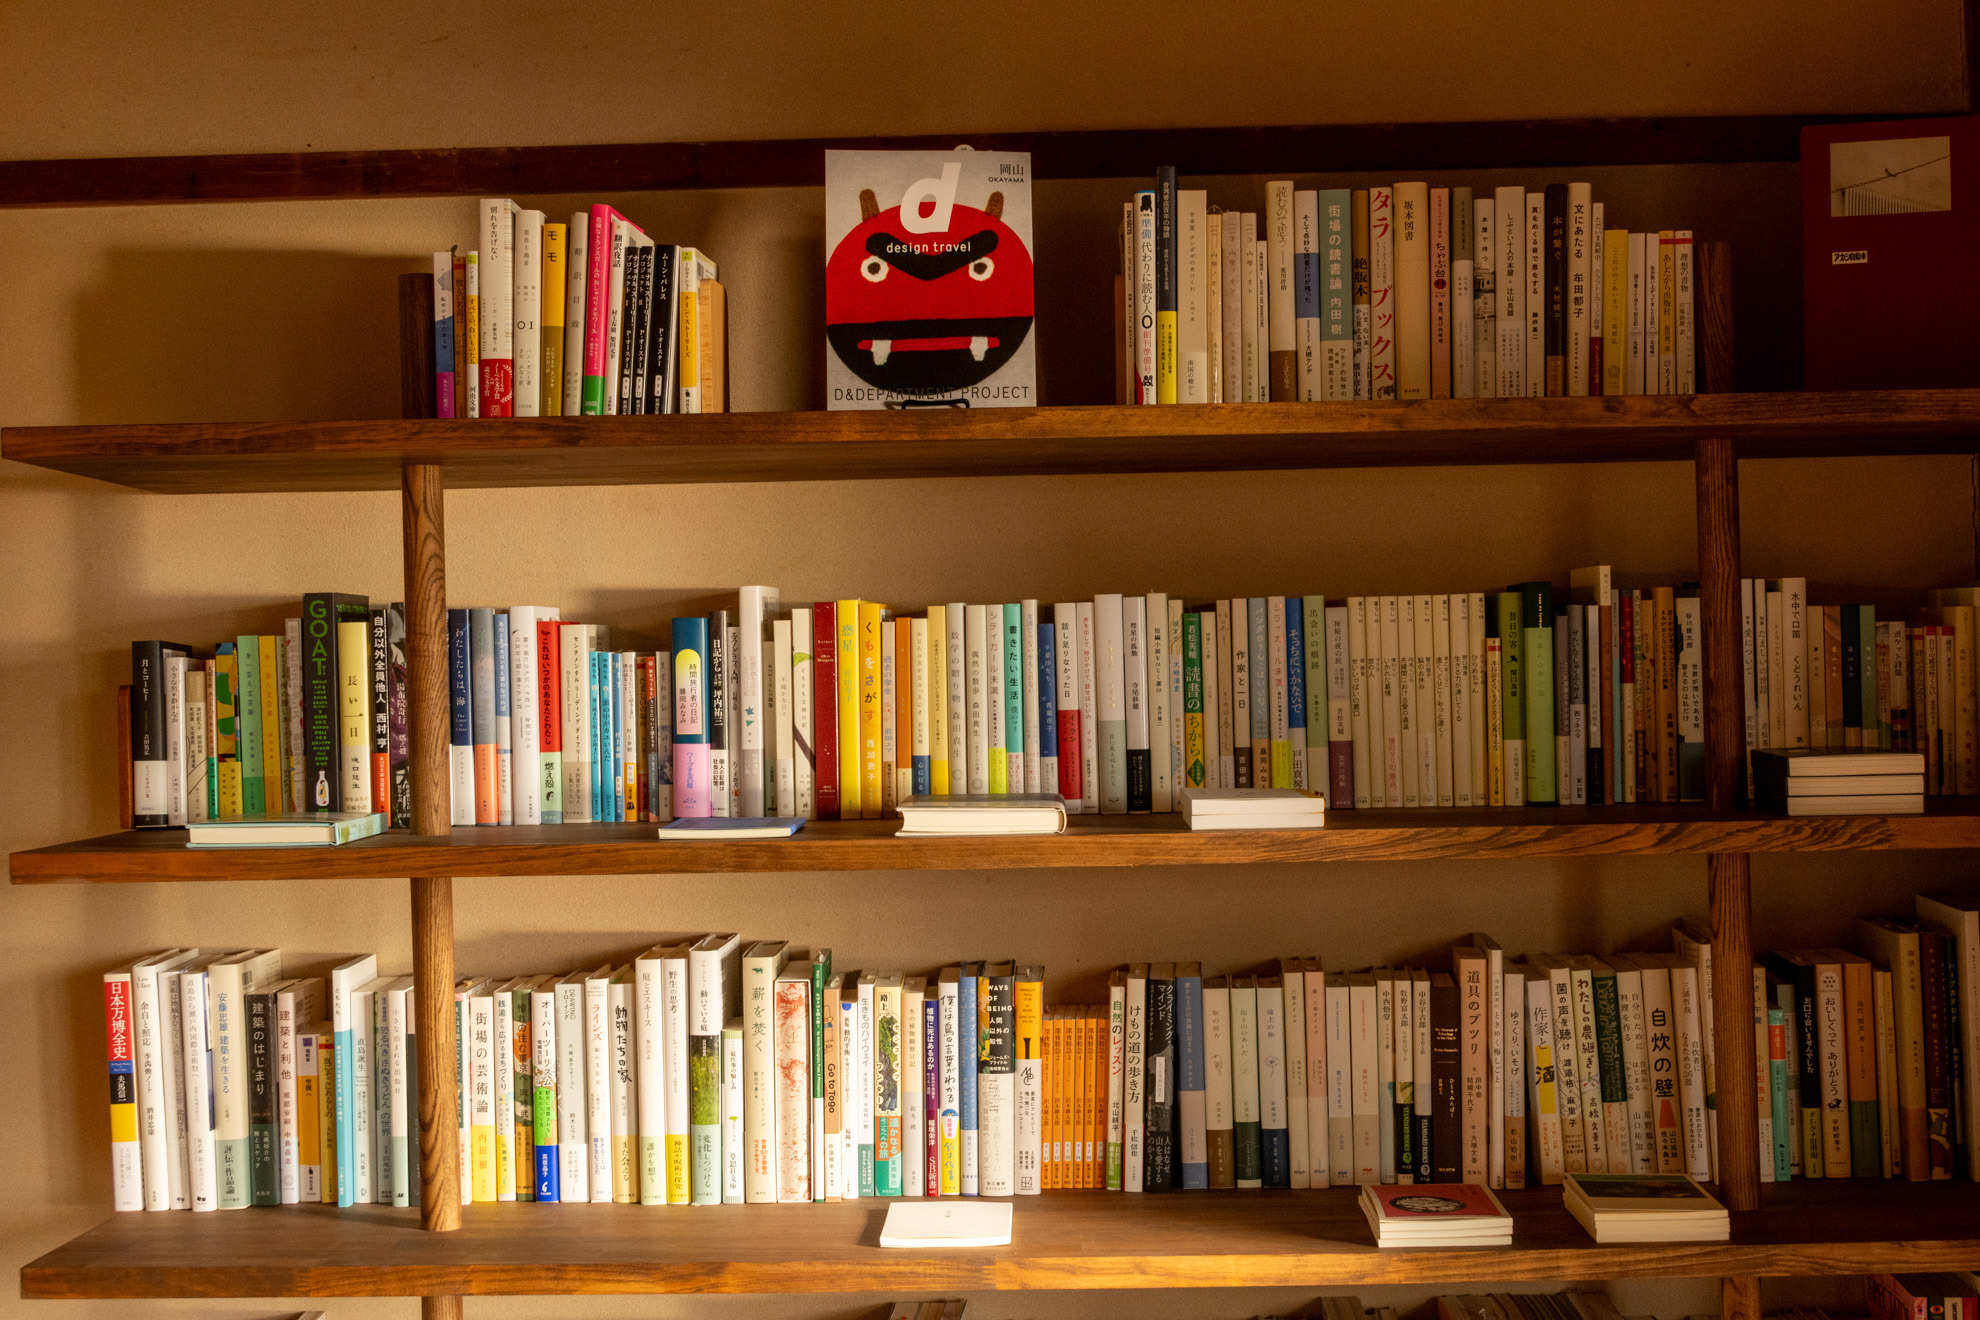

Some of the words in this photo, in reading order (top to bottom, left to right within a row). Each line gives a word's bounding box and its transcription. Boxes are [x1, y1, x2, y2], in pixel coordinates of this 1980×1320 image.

[1000, 163, 1024, 176] 岡山
[900, 163, 962, 234] d
[1403, 201, 1415, 241] 坂本図書
[489, 206, 499, 261] 別れを告げない
[548, 230, 559, 263] モモ
[613, 234, 623, 268] 翻訳夜話
[886, 242, 929, 254] design
[933, 241, 971, 253] travel
[1328, 204, 1343, 290] 街場の読書論
[1573, 204, 1584, 259] 文にあたる
[659, 253, 668, 300] ムーン・パレス
[1354, 258, 1368, 298] 絶版本
[1434, 242, 1447, 278] ちゃぶ台
[1680, 252, 1689, 293] 理想の書物
[1833, 252, 1867, 262] アカシ自動車
[1573, 273, 1584, 319] 牟田都子
[1663, 253, 1672, 316] あしたから出版社
[1330, 296, 1342, 336] 内田樹
[834, 387, 955, 401] D&DEPARTMENT
[961, 386, 1029, 399] PROJECT
[309, 599, 329, 676] GOAT
[1507, 612, 1518, 649] 昔日の客
[1685, 613, 1694, 649] 谷川俊太郎
[1790, 592, 1801, 639] 水中で口笛
[373, 616, 387, 704] 自分以外全員他人
[714, 639, 722, 675] 日記から
[731, 631, 739, 683] エスノグラフィ入門
[841, 628, 854, 653] 惑星
[990, 610, 1000, 696] シティガール未満
[1060, 621, 1070, 699] 話し足りなかった日
[1130, 621, 1138, 657] 彗星の孤独
[1152, 627, 1161, 694] 短編小説をひらく喜び
[1186, 625, 1198, 660] 若松英輔
[1253, 608, 1266, 695] パンダのうんこはいい匂い
[1308, 609, 1320, 671] 出会いの痕跡
[1333, 620, 1343, 664] 神秘の夜の旅
[1744, 628, 1753, 676] 愛について
[1758, 629, 1768, 695] たましいの世話
[1892, 630, 1903, 677] ポケット詩集
[142, 659, 150, 701] 月とコーヒー
[455, 627, 465, 706] わたしたちは、海
[864, 621, 877, 723] くもをさがす
[884, 655, 893, 696] 過去の学生
[951, 631, 962, 704] 数学の贈り物
[972, 650, 982, 696] 偶然の散歩
[1009, 624, 1019, 702] 書きたい生活
[1234, 654, 1246, 710] 作家と一日
[1289, 630, 1302, 714] そっちにいかないで
[1417, 657, 1425, 691] 脳のお休み
[1510, 669, 1518, 698] 関口良雄
[1792, 654, 1802, 711] くどうれいん
[343, 675, 364, 738] 長い一日
[396, 682, 407, 725] 湯布院奇行
[542, 637, 552, 746] これはいつかのあなたとわたし
[679, 687, 687, 724] 藤岡みなみ
[689, 663, 698, 724] 時間旅行者の日記
[714, 691, 724, 726] 坪内祐三
[1185, 671, 1201, 711] 読書の
[1454, 655, 1463, 722] 生きる力が湧いてくる
[1681, 664, 1689, 721] 答えるのは私だけ
[1692, 663, 1700, 728] 世界が問いである時
[885, 727, 893, 753] 前田エマ
[953, 711, 963, 759] 森田真生
[974, 702, 982, 738] 森田真生
[1188, 714, 1202, 762] ちから
[351, 757, 361, 789] 滝口悠生
[545, 761, 555, 789] 燃え殻
[866, 738, 876, 782] 西加奈子
[642, 972, 653, 1028] 庭とエスキース
[668, 970, 679, 1014] 野生の思考
[700, 989, 709, 1032] 動いている庭
[880, 993, 888, 1012] 路上
[987, 984, 1009, 992] WAYS
[1157, 984, 1166, 1022] マインド
[1382, 990, 1392, 1022] 中西悟堂
[1399, 989, 1409, 1028] 牧野富太郎
[1418, 990, 1427, 1029] 中谷宇吉郎
[1682, 982, 1692, 1014] 三浦哲哉
[111, 981, 128, 1060] 日本万博全史
[140, 1002, 152, 1047] 余白と照応
[217, 993, 229, 1031] 安藤忠雄
[592, 1003, 602, 1041] ラインズ
[751, 987, 767, 1053] 薪を焚く
[861, 997, 870, 1066] 生きものハイウェイ
[989, 1017, 1003, 1025] 人間
[989, 1027, 1010, 1035] 以外の
[1240, 1009, 1249, 1057] 街と山のあいだ
[1266, 1009, 1276, 1039] 途上の旅
[1467, 970, 1482, 1055] 道具のブツリ
[1533, 1006, 1549, 1050] 作家と
[1555, 983, 1571, 1052] 菌の声を聴け
[1577, 978, 1593, 1070] わたしの農継ぎ
[1620, 994, 1632, 1042] 料理を作る
[1631, 993, 1643, 1051] 自分のために
[1824, 997, 1835, 1048] おいしくって
[253, 1003, 266, 1096] 建築のはじまり
[280, 1010, 293, 1080] 建築と利他
[357, 1036, 367, 1073] 直島誕生
[393, 1009, 403, 1096] 小さな泊まれる出版社
[541, 1000, 553, 1087] オーバーツーリズム
[615, 1005, 632, 1084] 動物たちの家
[843, 1029, 851, 1055] 動的平衡
[926, 1007, 934, 1070] 植物に死はあるのか
[942, 995, 956, 1104] 僕には鳥の言葉がわかる
[989, 1038, 1004, 1046] 知性
[1112, 999, 1123, 1076] 自然のレッスン
[1127, 1006, 1142, 1105] けもの道の歩き方
[1510, 1011, 1520, 1076] ゆっくり、いそげ
[1650, 1008, 1676, 1098] 自炊の壁
[1690, 1040, 1701, 1072] 自炊者に
[1803, 997, 1814, 1074] お口に合いませんでした
[170, 979, 180, 1041] 美術は地域をひらく
[177, 1107, 186, 1140] 北川フラム
[220, 1035, 230, 1095] 建築を生きる
[476, 1011, 490, 1114] 街場の芸術論
[828, 1063, 836, 1080] Go
[1535, 1065, 1555, 1086] 酒
[1828, 1051, 1840, 1097] ありがとう
[284, 1092, 292, 1126] 堀部安嗣
[323, 1057, 334, 1119] 既にそこにあるもの
[829, 1090, 837, 1114] Togo
[1466, 1076, 1475, 1115] 結城千代子
[1475, 1076, 1483, 1099] 田中幸
[1112, 1102, 1120, 1132] 北山耕平
[1589, 1096, 1601, 1153] 高橋久美子
[1632, 1111, 1643, 1150] 山口祐加
[285, 1131, 293, 1166] 中島岳志
[478, 1131, 489, 1169] 内田樹
[646, 1142, 655, 1185] 誰かを想う
[702, 1135, 712, 1188] 変化しつづける
[1154, 1136, 1163, 1184] 山を愛する
[1470, 1134, 1478, 1165] 大塚文香
[1510, 1128, 1518, 1163] 影山知明
[224, 1145, 236, 1196] 評伝・作品論
